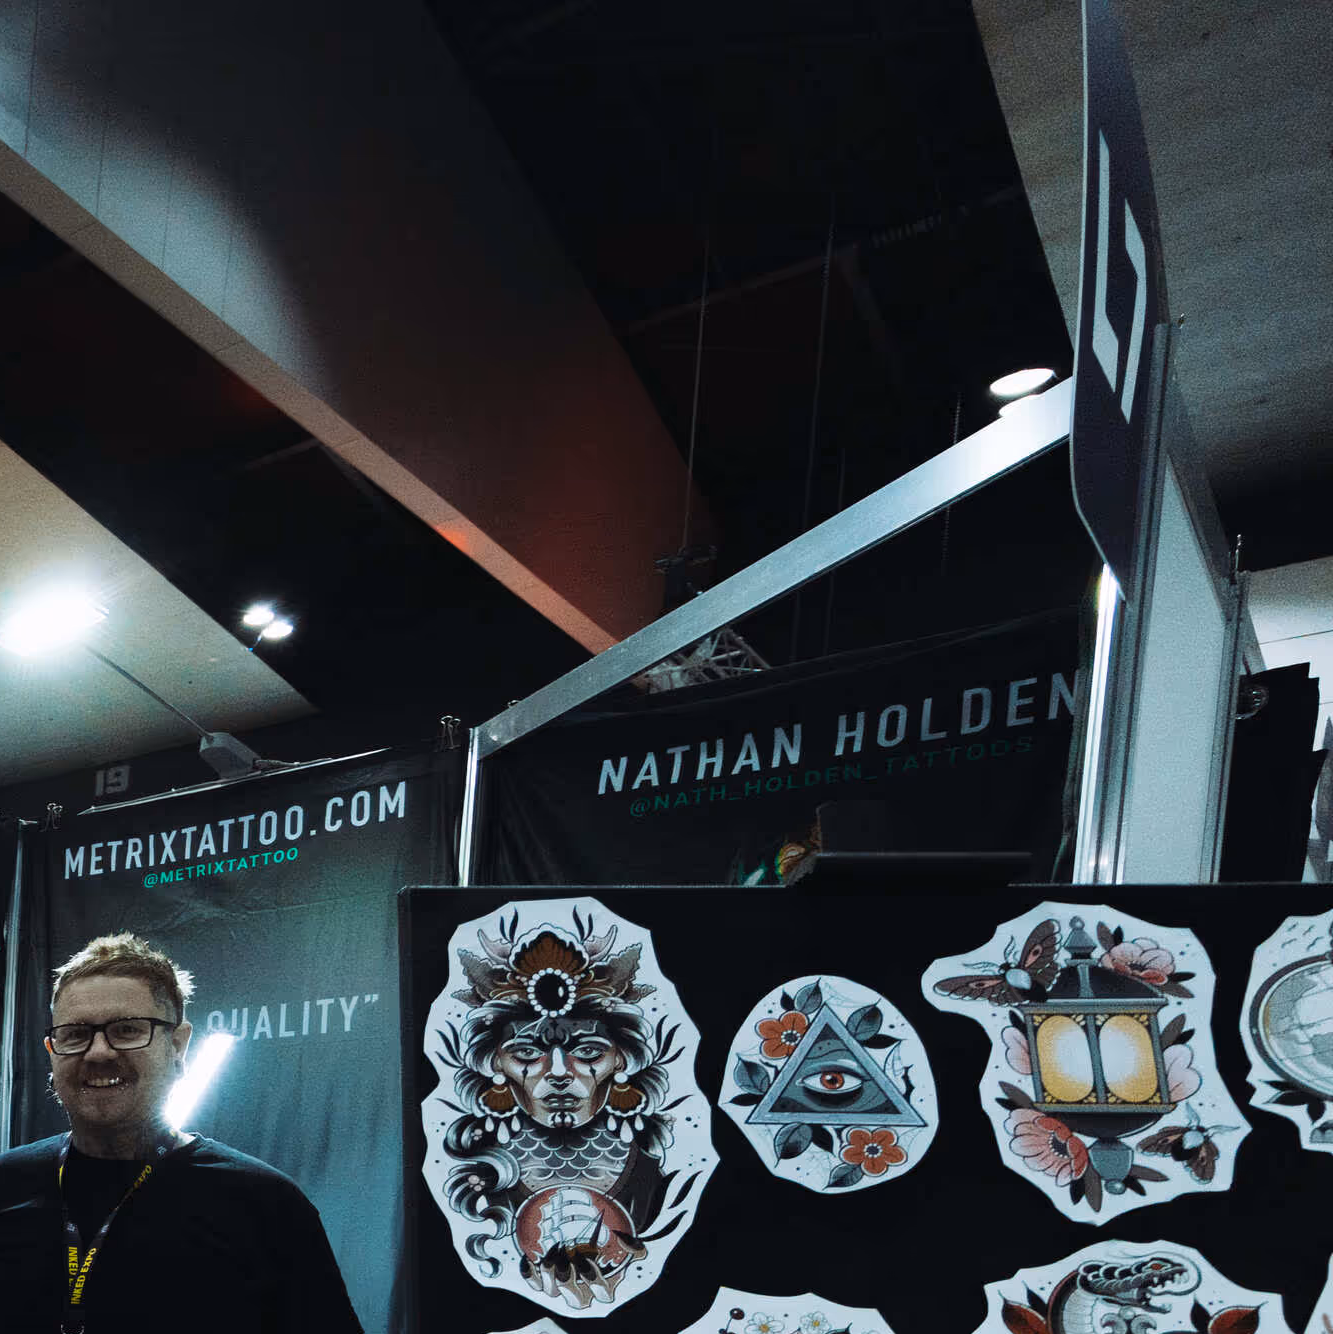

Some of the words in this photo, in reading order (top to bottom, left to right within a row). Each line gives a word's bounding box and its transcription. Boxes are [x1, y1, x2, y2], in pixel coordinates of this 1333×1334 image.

[598, 722, 803, 796] NATHAN
[834, 671, 1083, 756] HOLDEN
[94, 764, 130, 797] 19
[64, 781, 408, 880] METRIXTATTOO.COM
[143, 847, 300, 889] @METRIXTATTOO
[68, 1246, 78, 1276] INKED
[70, 1274, 86, 1305] INKED
[80, 1247, 97, 1274] EXPO
